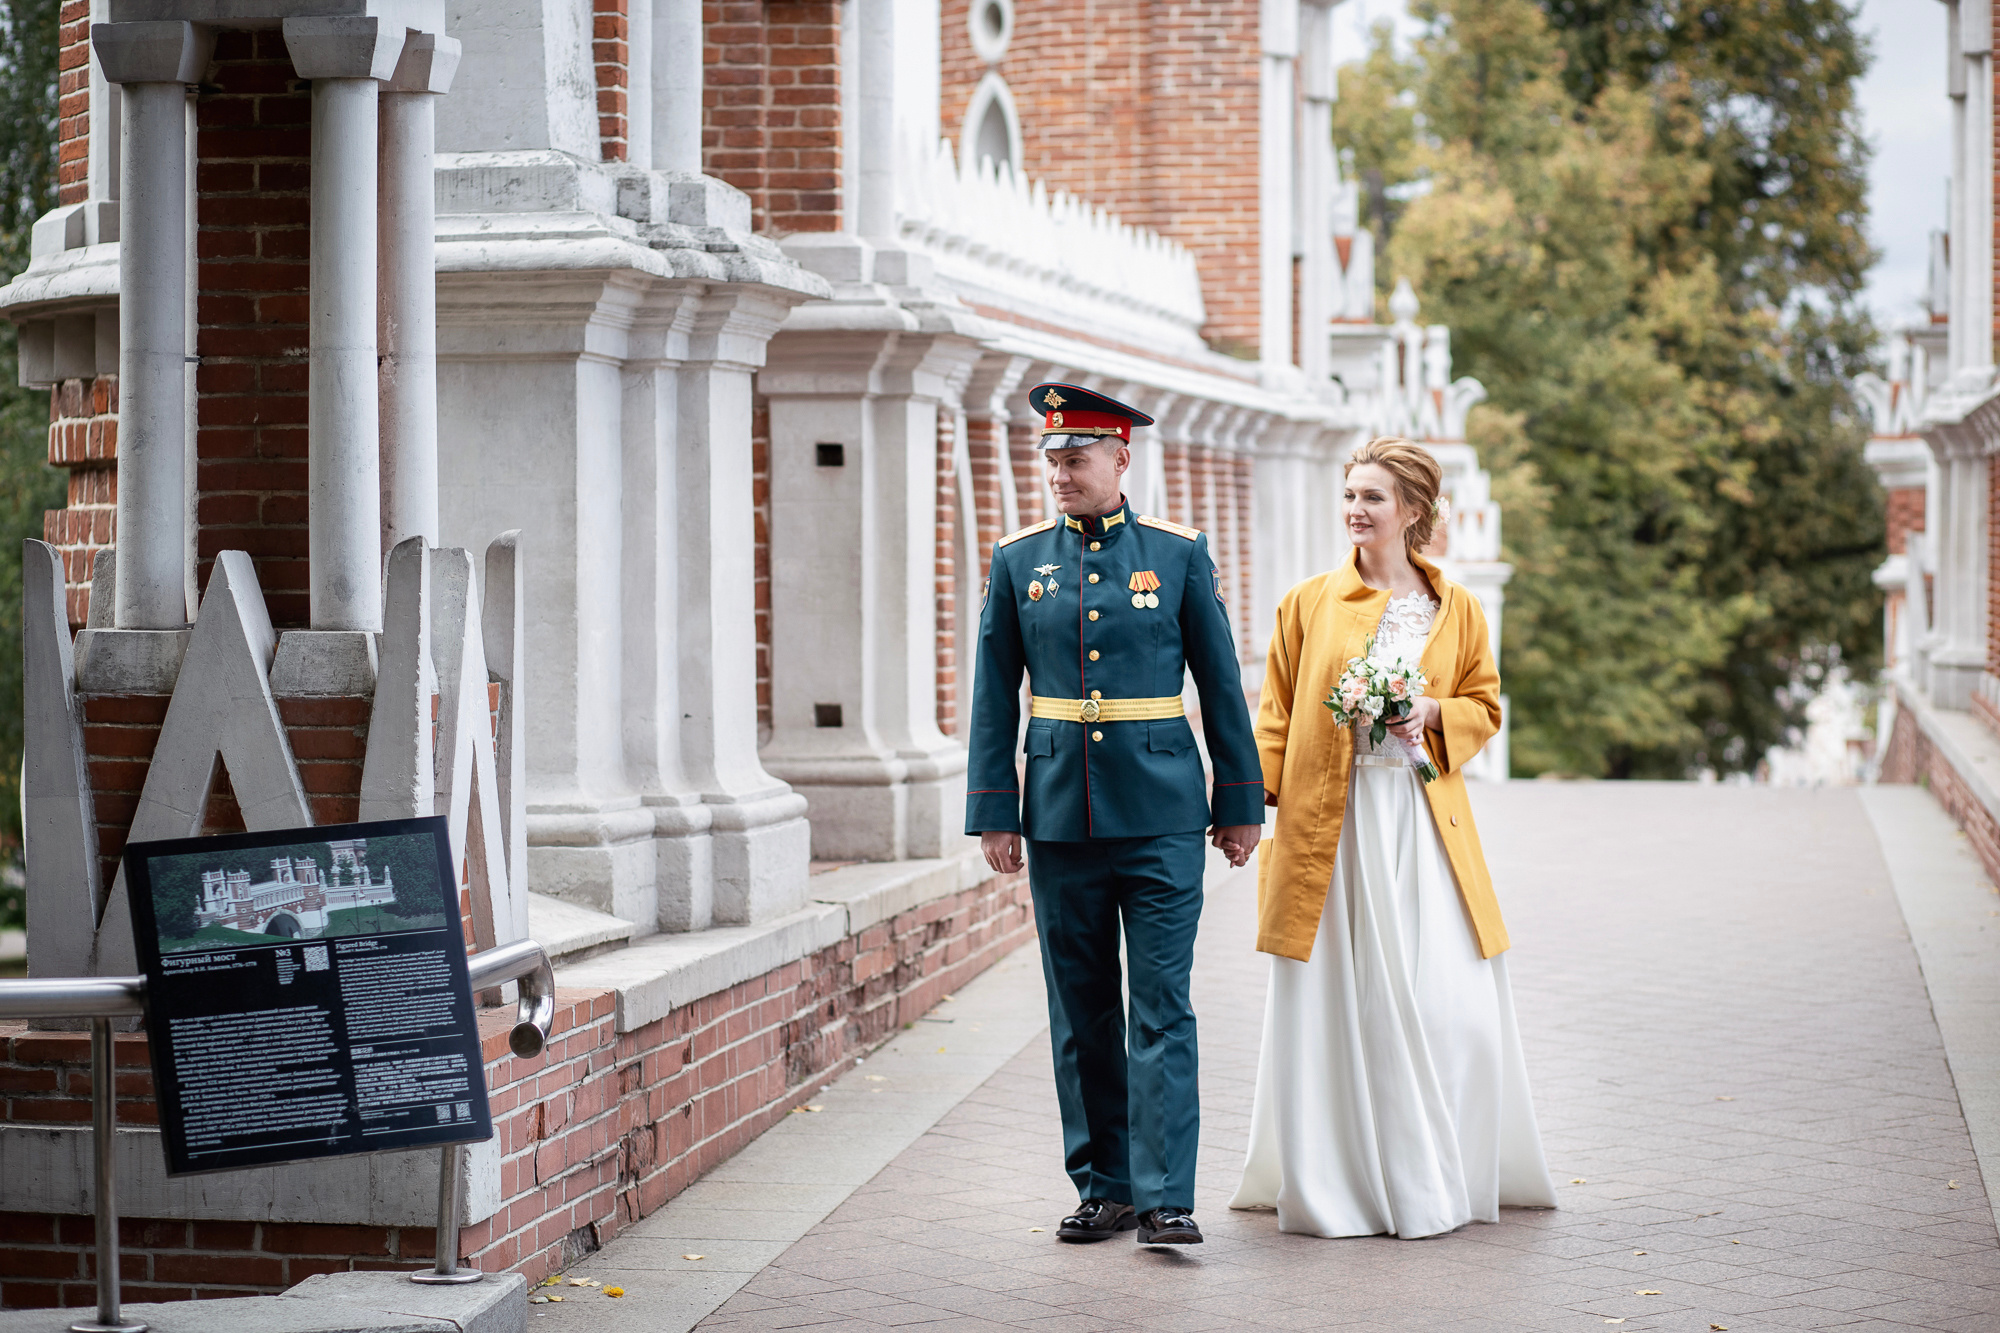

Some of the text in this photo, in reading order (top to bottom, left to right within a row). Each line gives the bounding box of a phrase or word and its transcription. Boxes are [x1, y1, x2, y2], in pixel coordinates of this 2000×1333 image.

[335, 941, 358, 949] Figured
[275, 948, 291, 958] №3
[161, 953, 237, 967] Фигурный мост
